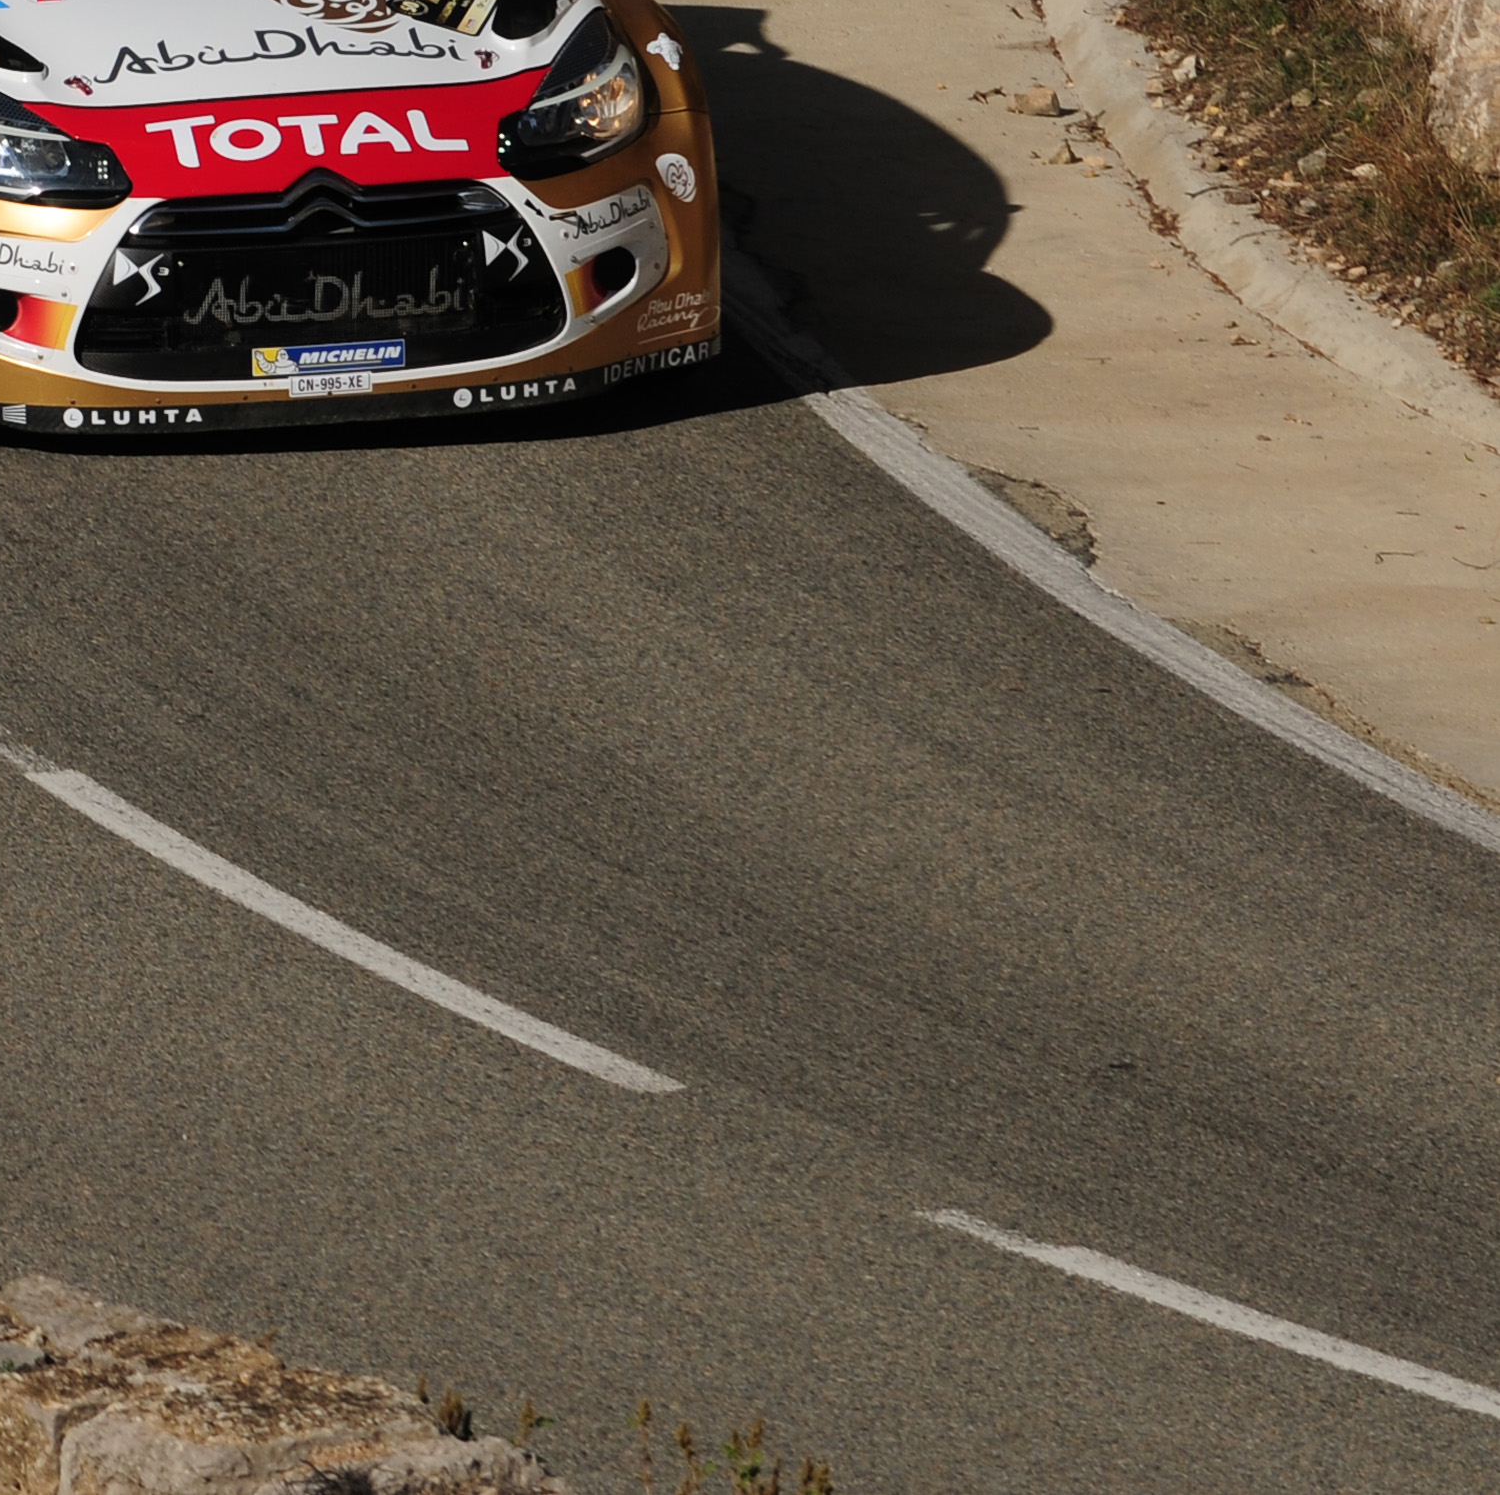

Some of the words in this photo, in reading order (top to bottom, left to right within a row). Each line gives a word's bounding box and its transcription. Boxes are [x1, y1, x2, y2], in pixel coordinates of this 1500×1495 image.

[145, 109, 470, 168] TOTAL
[637, 307, 709, 333] Racing
[299, 346, 402, 364] MICHELIN
[604, 341, 709, 384] IDENTICAR
[298, 375, 363, 392] CN-995-XE
[480, 378, 576, 402] LUHTA
[90, 408, 203, 426] LUHTA
